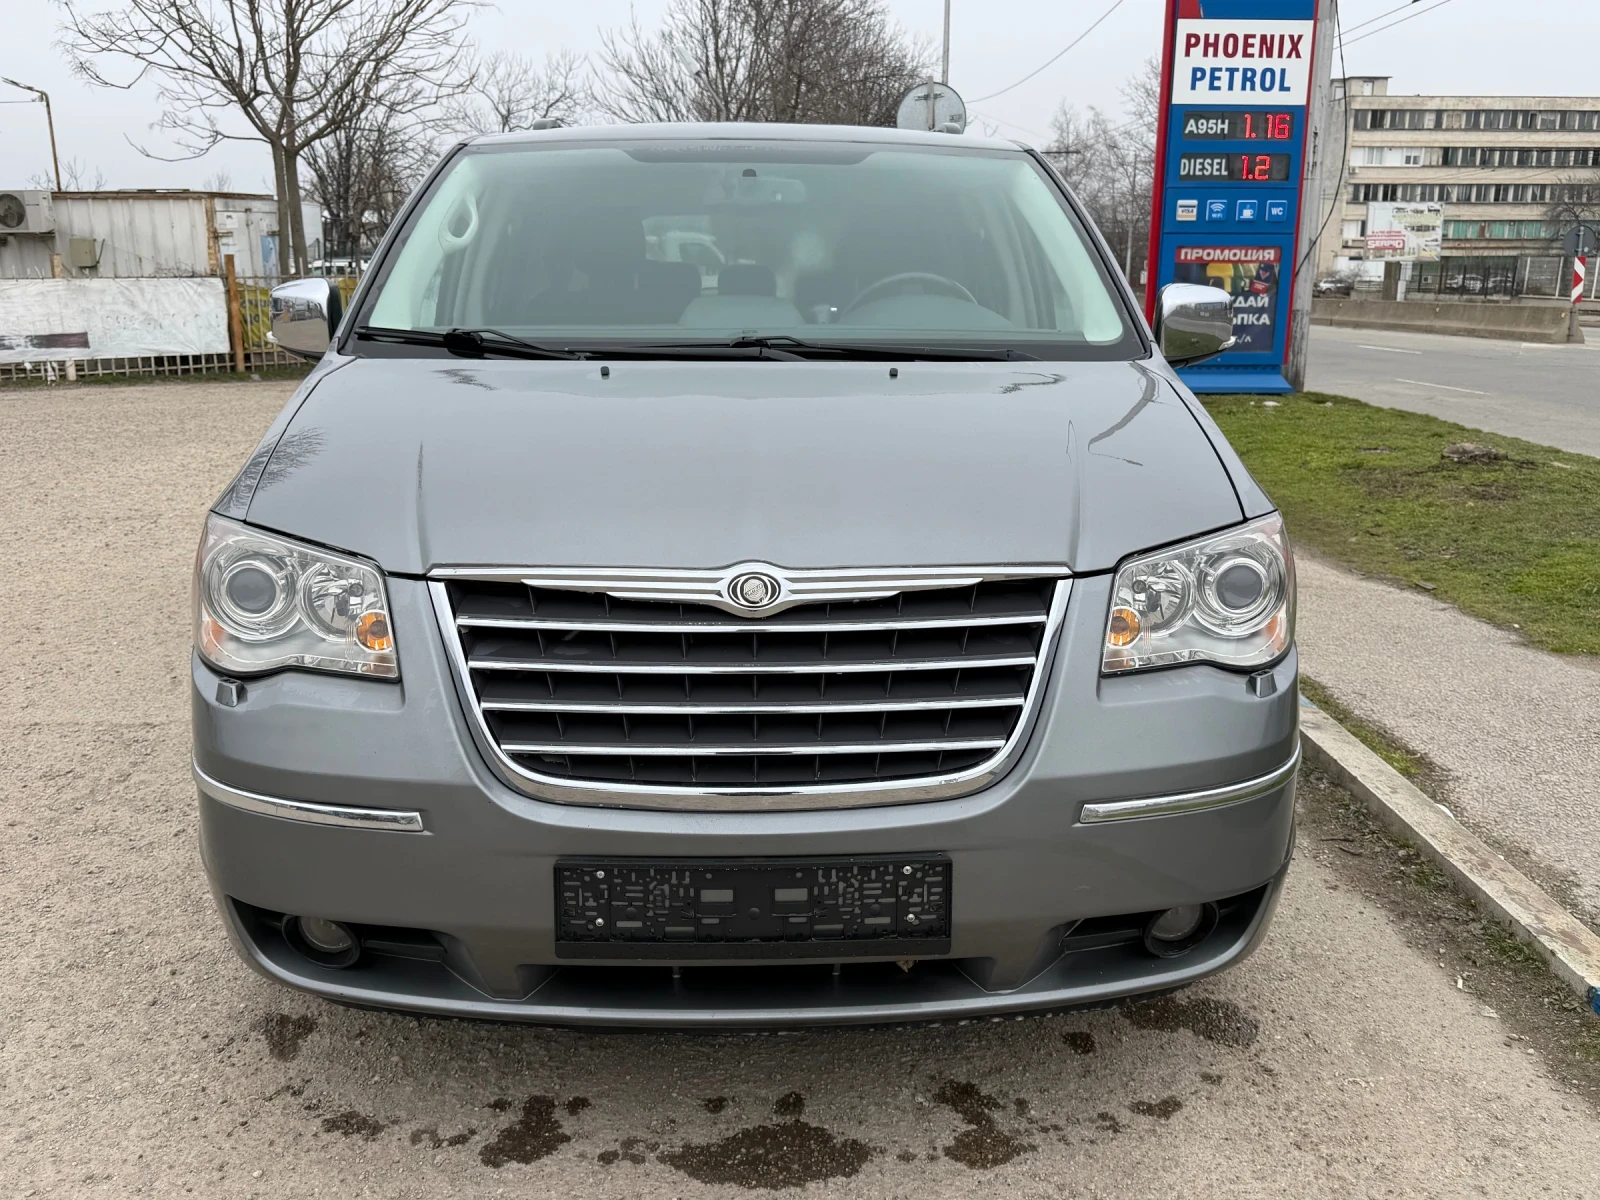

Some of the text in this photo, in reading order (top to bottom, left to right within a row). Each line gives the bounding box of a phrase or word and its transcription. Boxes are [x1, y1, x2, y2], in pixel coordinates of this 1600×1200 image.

[1184, 32, 1304, 59] PHOENIX
[1189, 66, 1291, 92] PETROL
[1184, 118, 1229, 134] A95H
[1180, 158, 1229, 176] DIESEL
[1271, 207, 1283, 215] WC
[1180, 248, 1275, 261] ПРОМОЦИЯ
[1230, 293, 1269, 307] ДАЙ
